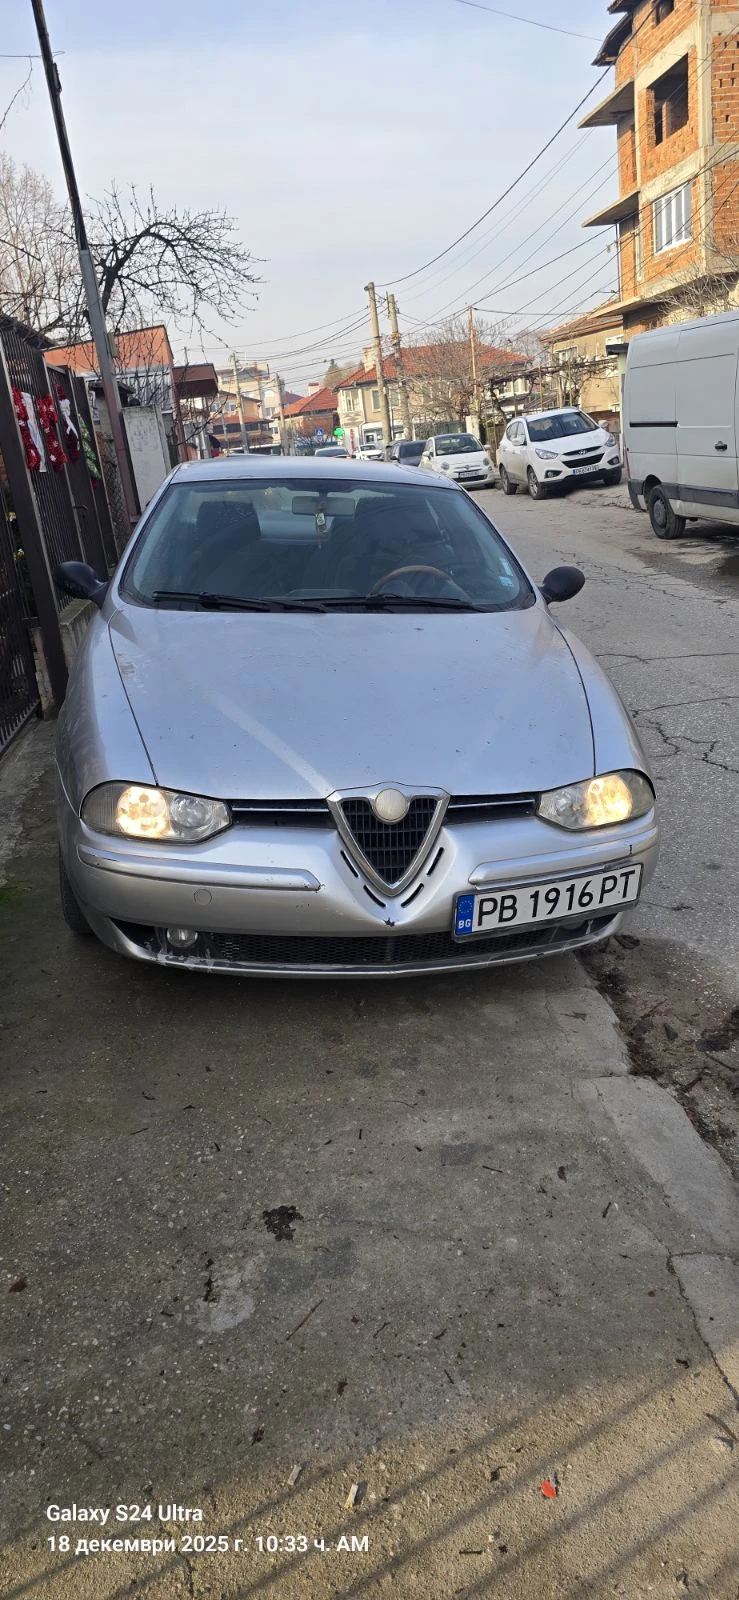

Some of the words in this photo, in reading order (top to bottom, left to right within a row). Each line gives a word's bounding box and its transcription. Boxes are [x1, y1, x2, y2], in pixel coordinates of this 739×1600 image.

[477, 895, 518, 926] PB
[530, 881, 593, 918] 1916
[598, 869, 636, 904] PT
[458, 919, 471, 929] BG
